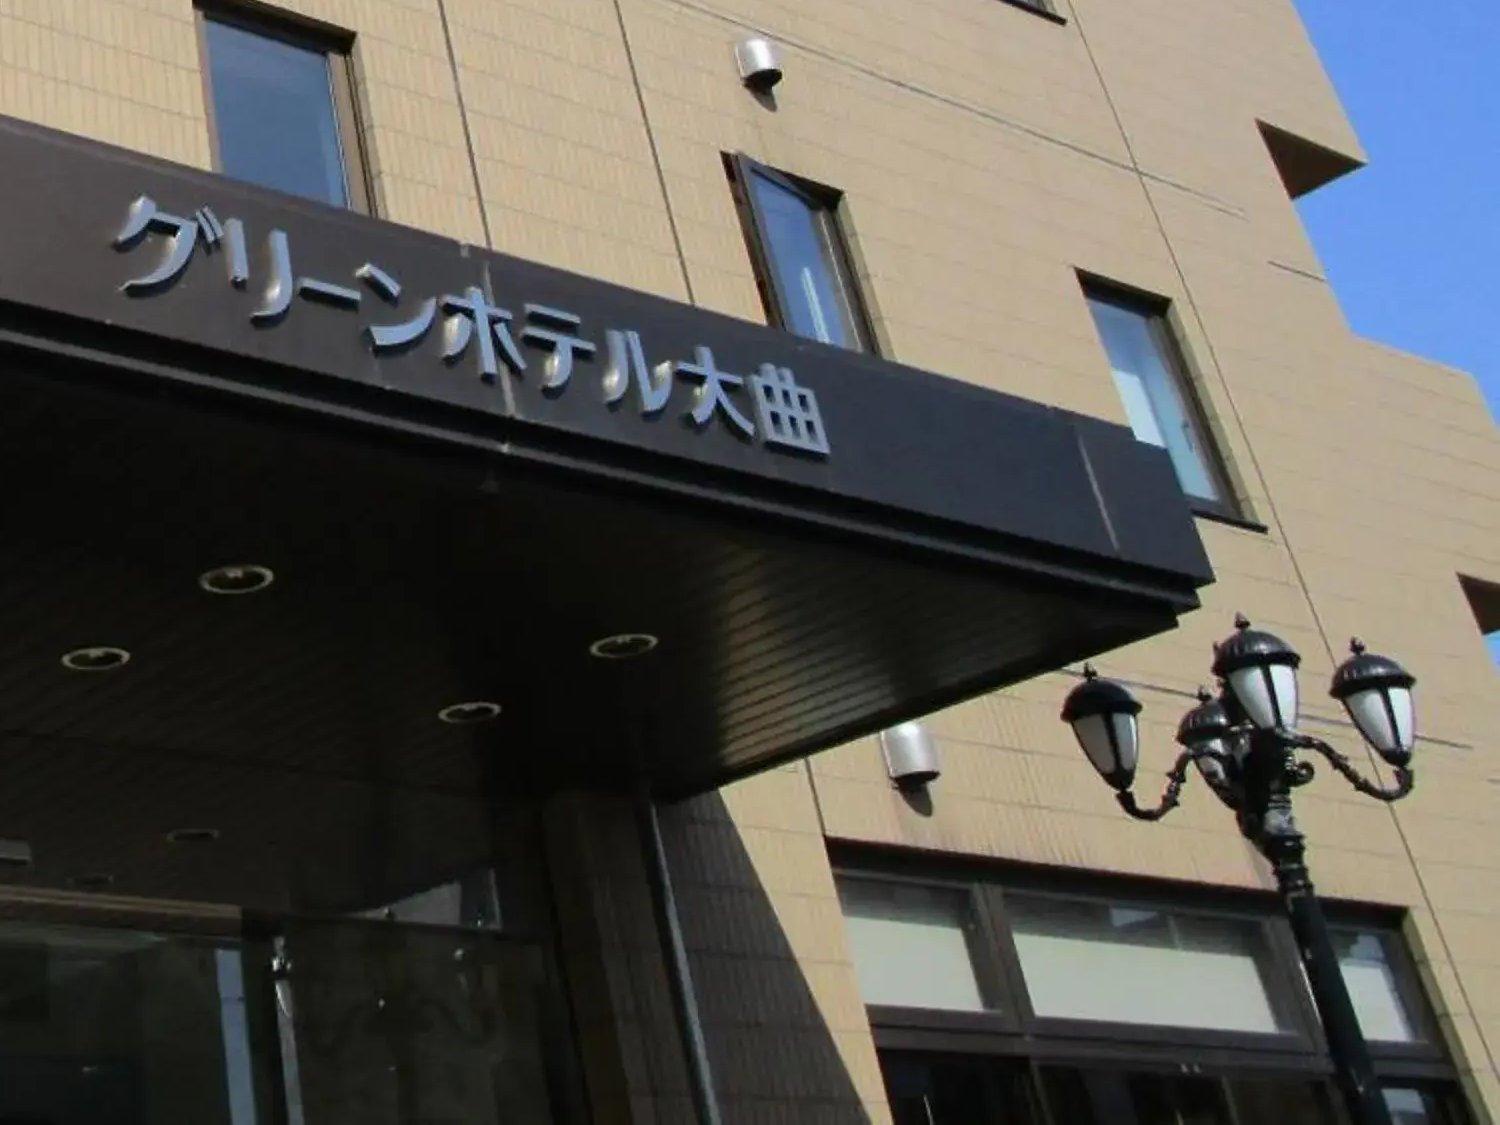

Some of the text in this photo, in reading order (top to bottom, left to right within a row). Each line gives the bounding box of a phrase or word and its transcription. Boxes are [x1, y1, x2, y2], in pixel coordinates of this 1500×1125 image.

[112, 195, 830, 455] グリーンホテル大曲
